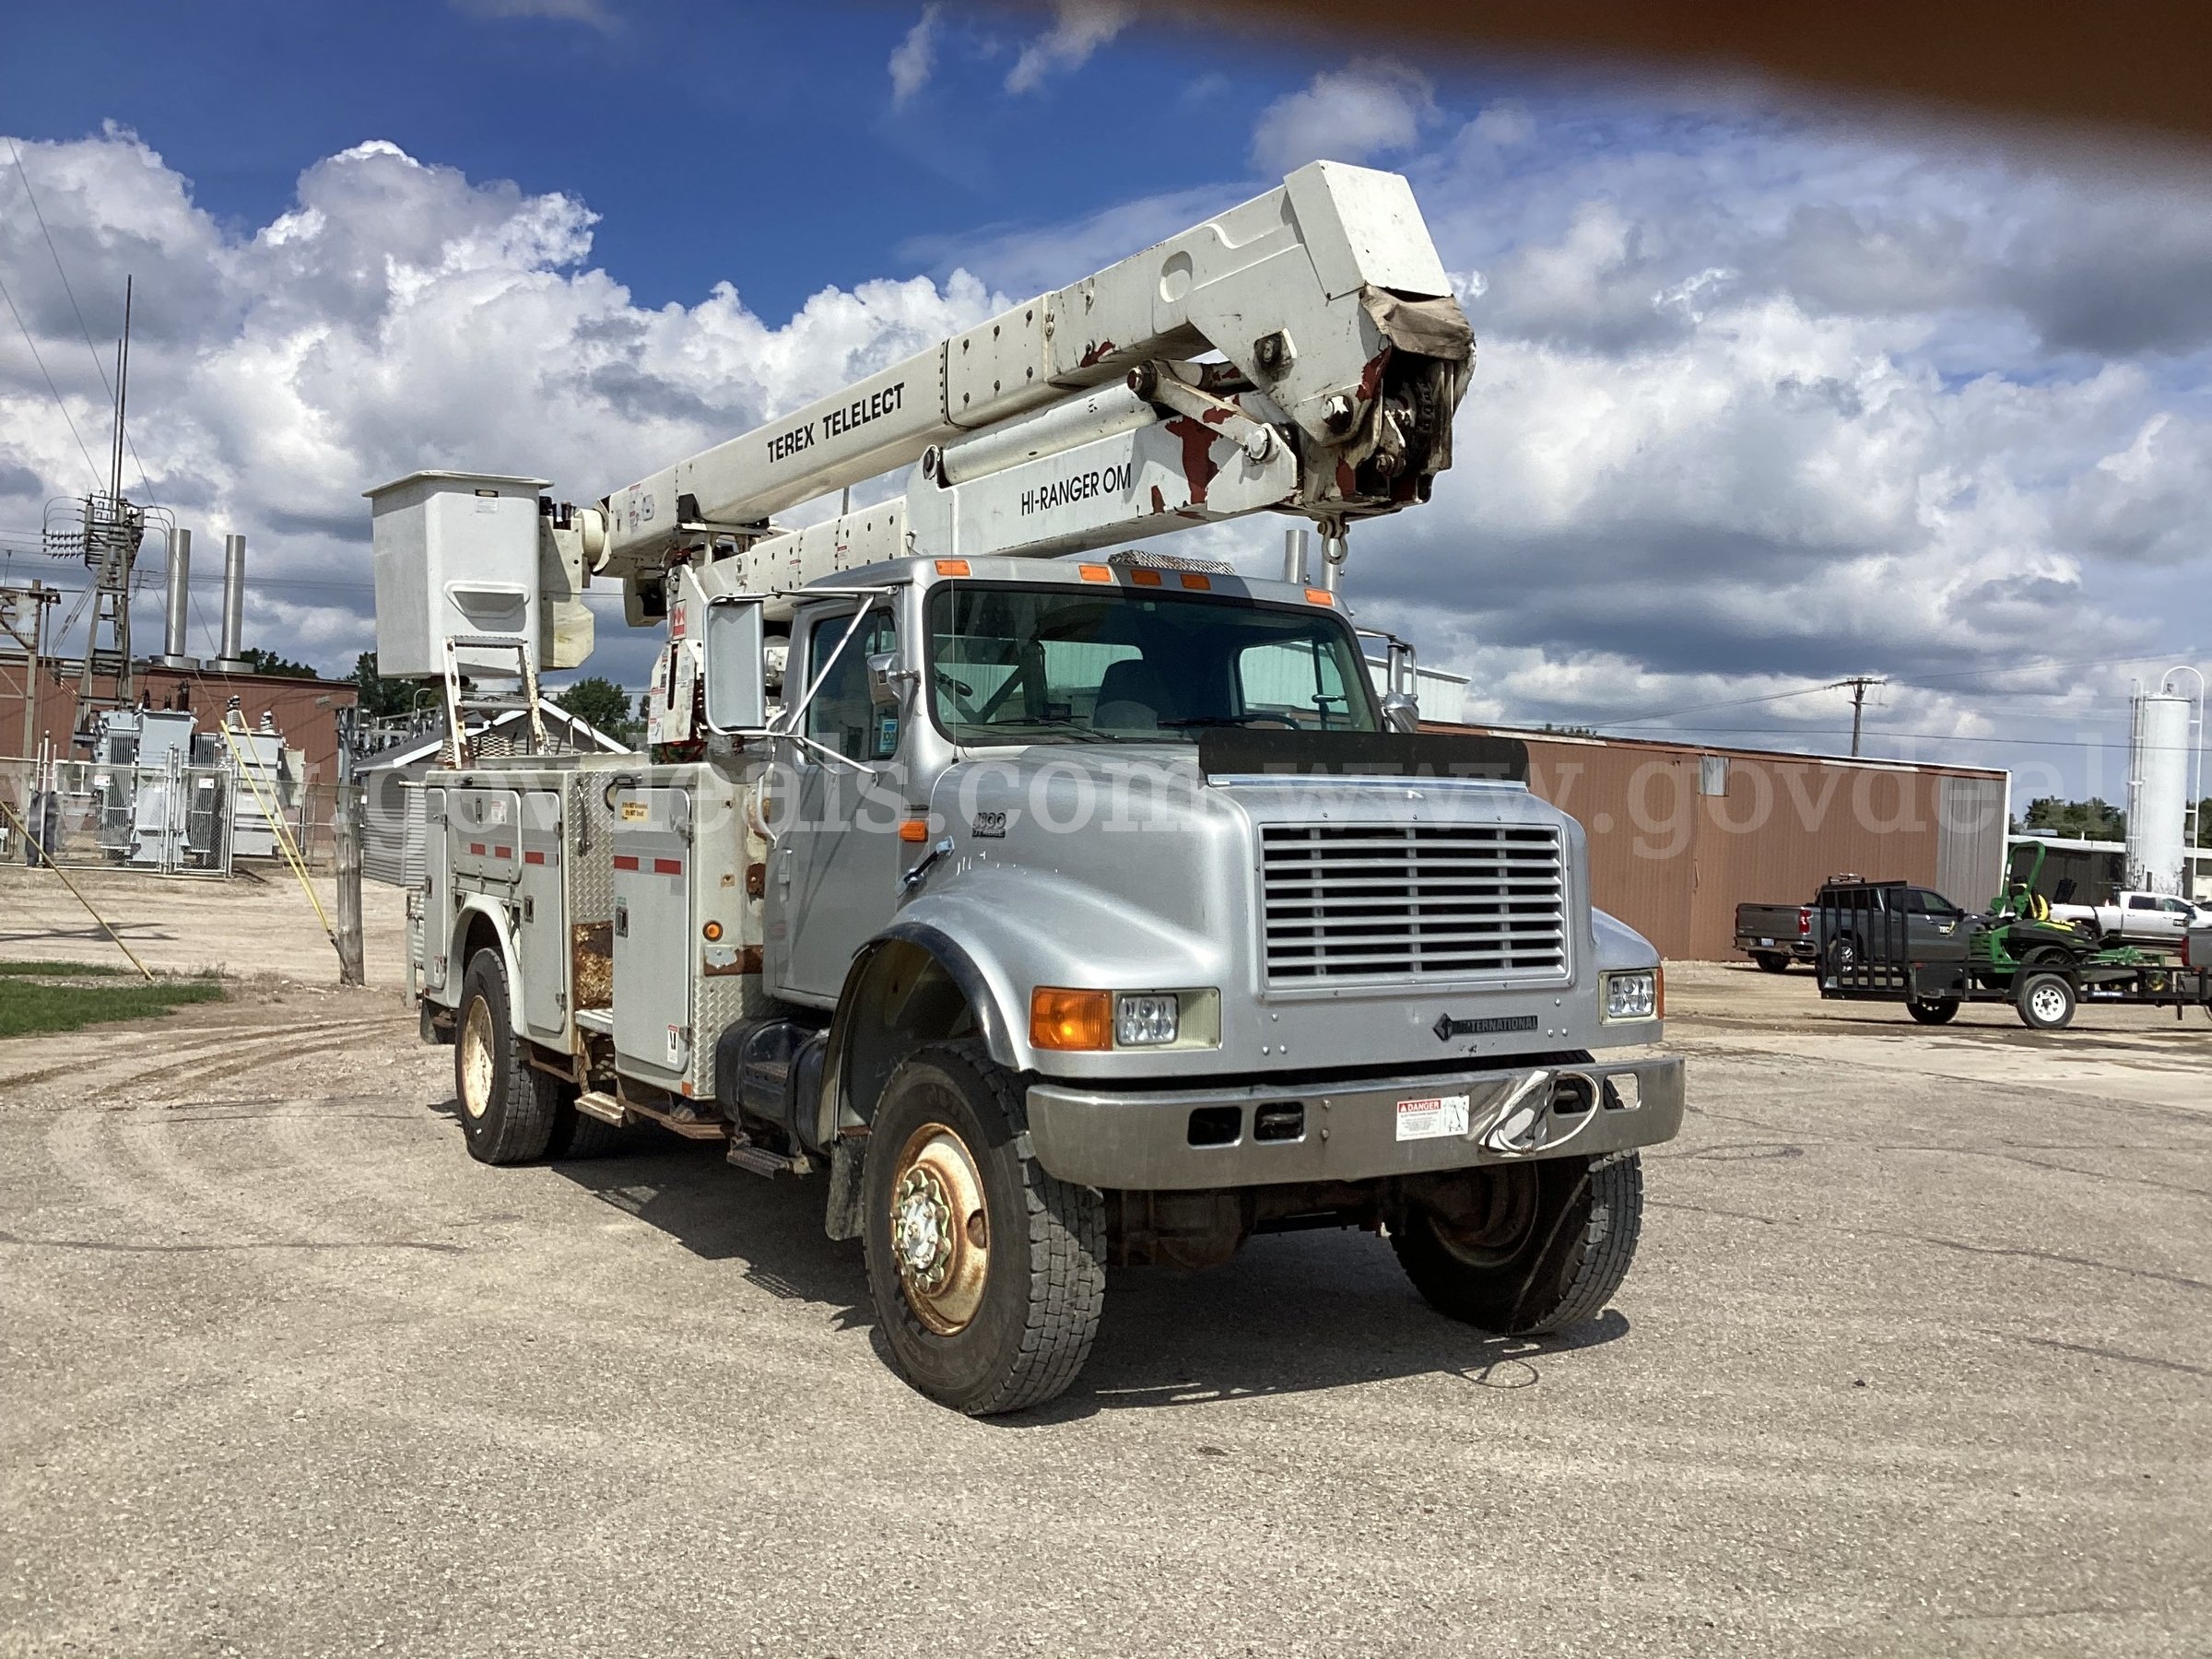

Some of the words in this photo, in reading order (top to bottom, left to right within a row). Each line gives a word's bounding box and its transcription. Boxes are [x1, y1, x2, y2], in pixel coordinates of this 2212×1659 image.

[767, 422, 815, 463] TEREX
[822, 382, 904, 440] TELELECT
[1021, 471, 1100, 516] HI-RANGER
[1102, 463, 1132, 493] OM
[1459, 1017, 1537, 1033] TERNATIONAL
[1407, 1100, 1440, 1112] DANGER
